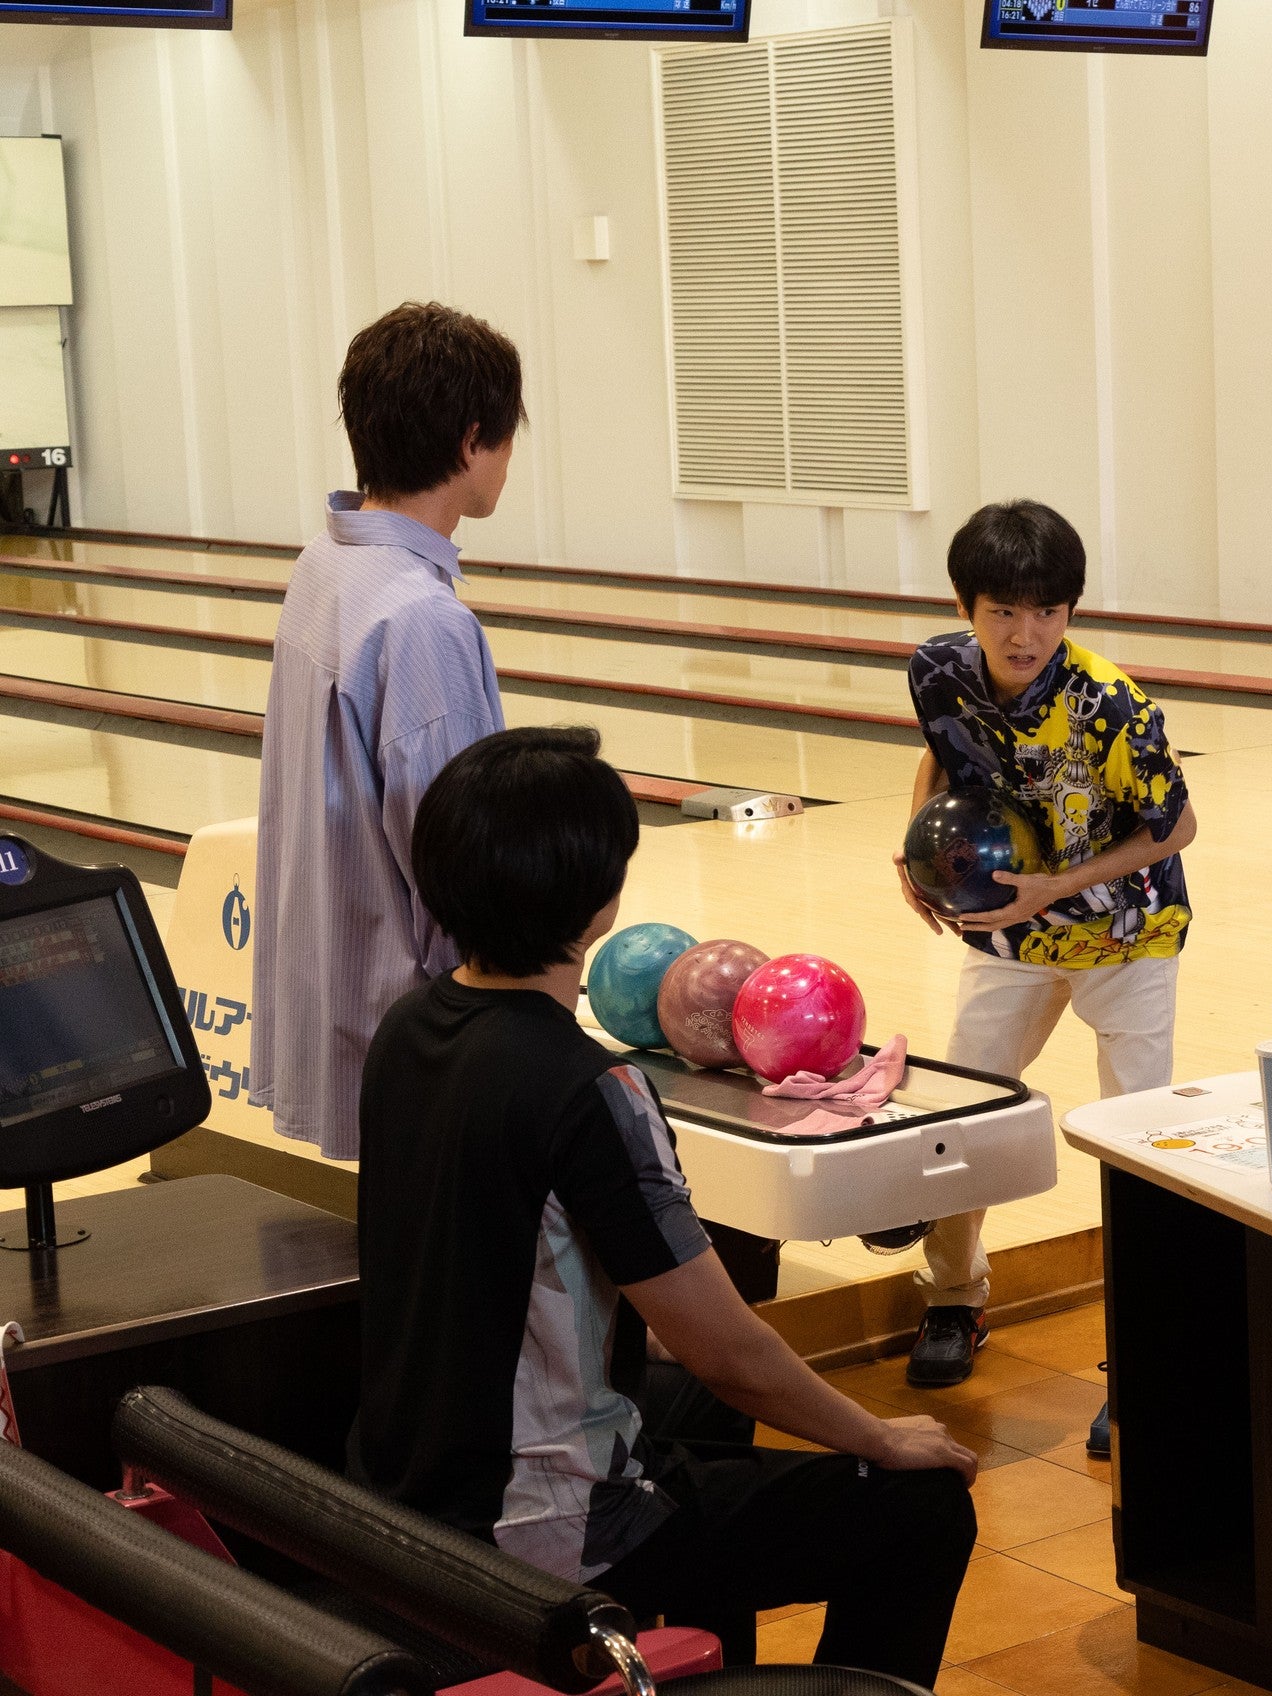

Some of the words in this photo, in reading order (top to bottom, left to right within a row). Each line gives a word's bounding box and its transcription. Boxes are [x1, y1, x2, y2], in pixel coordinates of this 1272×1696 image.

[1001, 11, 1020, 20] 16:21
[1189, 2, 1200, 12] 86
[41, 448, 66, 466] 16
[0, 851, 19, 873] 11
[178, 987, 252, 1035] ルア
